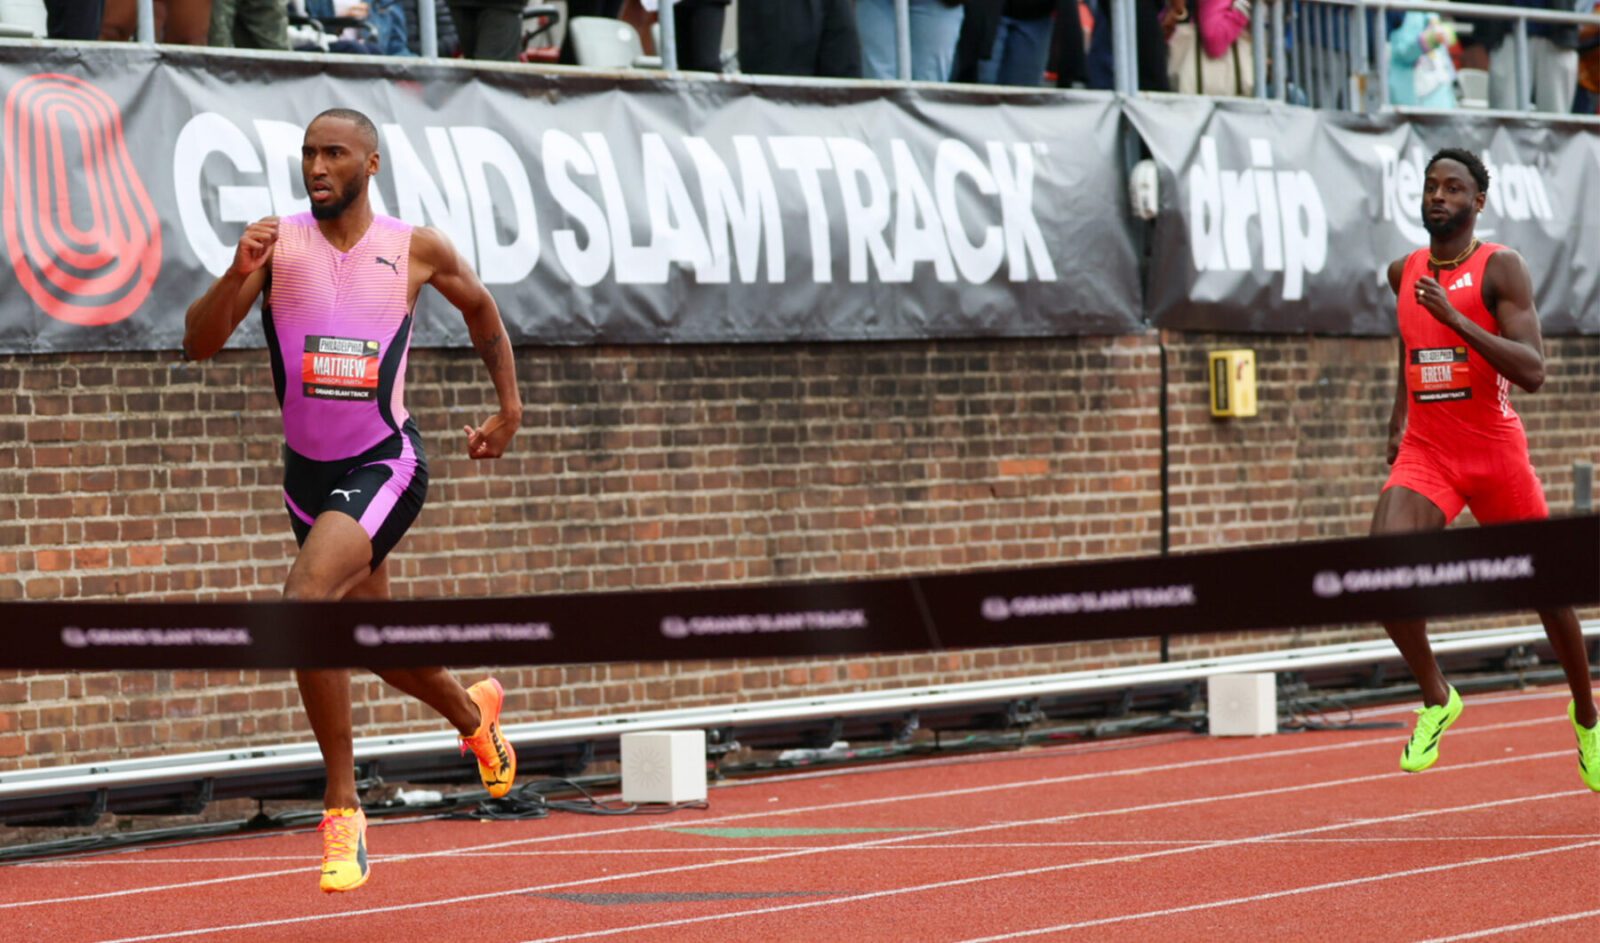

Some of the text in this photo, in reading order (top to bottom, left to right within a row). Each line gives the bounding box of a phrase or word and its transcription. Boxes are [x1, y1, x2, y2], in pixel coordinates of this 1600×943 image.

[174, 112, 1057, 287] GRND SLAM TRACK
[1190, 136, 1327, 300] drip
[313, 356, 367, 378] MATTHEW
[1421, 365, 1452, 383] JEREEM
[1342, 555, 1534, 592] GRAND SLAM TRACK
